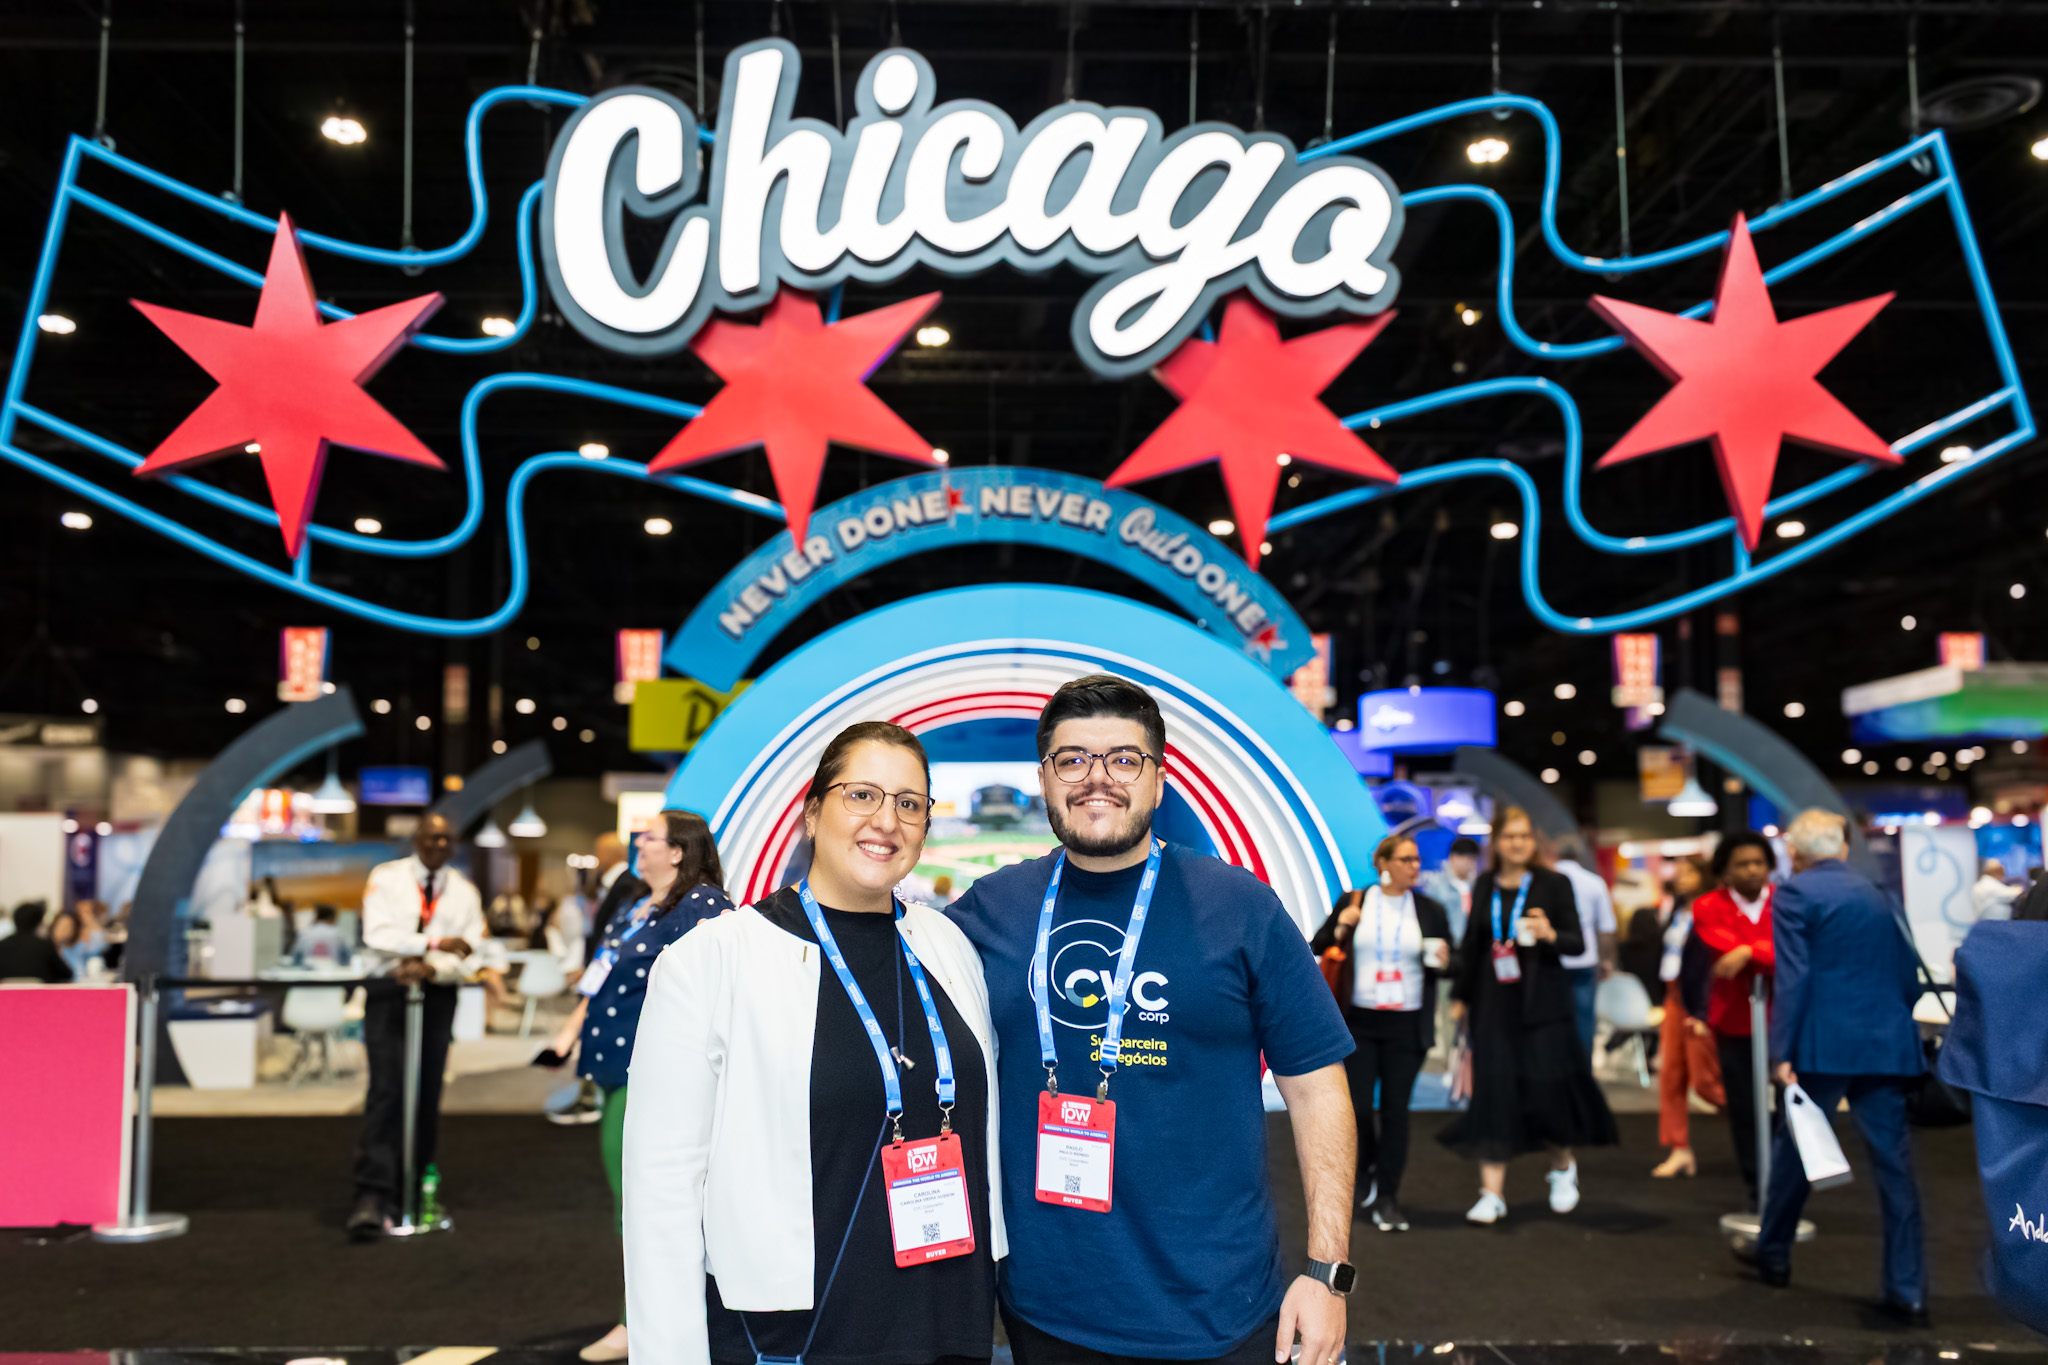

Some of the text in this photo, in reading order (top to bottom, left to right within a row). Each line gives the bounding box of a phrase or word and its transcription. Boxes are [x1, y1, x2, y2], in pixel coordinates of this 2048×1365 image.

[554, 49, 1392, 357] Chicago
[719, 535, 833, 637] NEVER
[838, 490, 947, 550] DONE
[980, 485, 1112, 531] NEVER
[1138, 1011, 1170, 1025] corp
